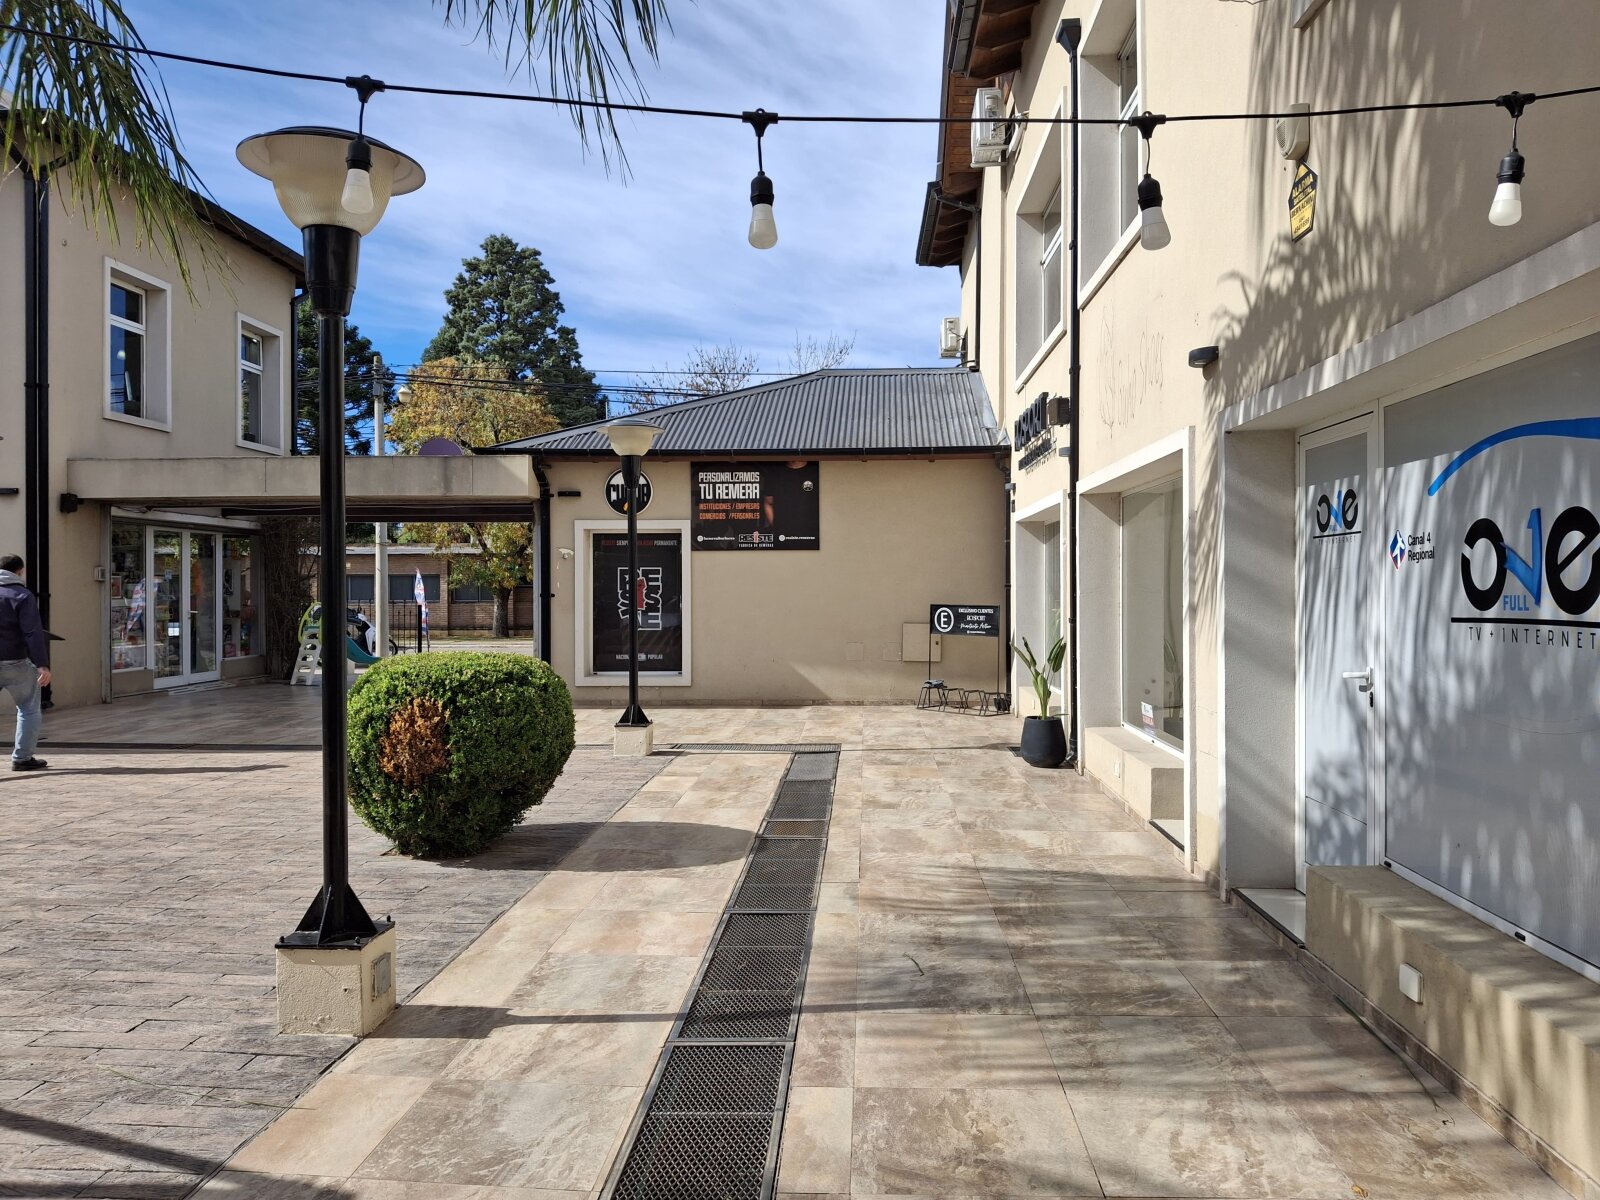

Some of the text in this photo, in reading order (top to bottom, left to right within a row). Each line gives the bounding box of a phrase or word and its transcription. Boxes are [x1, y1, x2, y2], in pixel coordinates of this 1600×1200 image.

[698, 472, 760, 482] PERSONALIZAMOS
[698, 483, 760, 500] TU REMERA
[1407, 532, 1431, 546] Canal 4
[1407, 546, 1435, 564] Regional
[1503, 594, 1529, 611] FULL
[940, 612, 948, 628] E
[1469, 626, 1481, 641] TV
[1502, 627, 1597, 650] INTERNET
